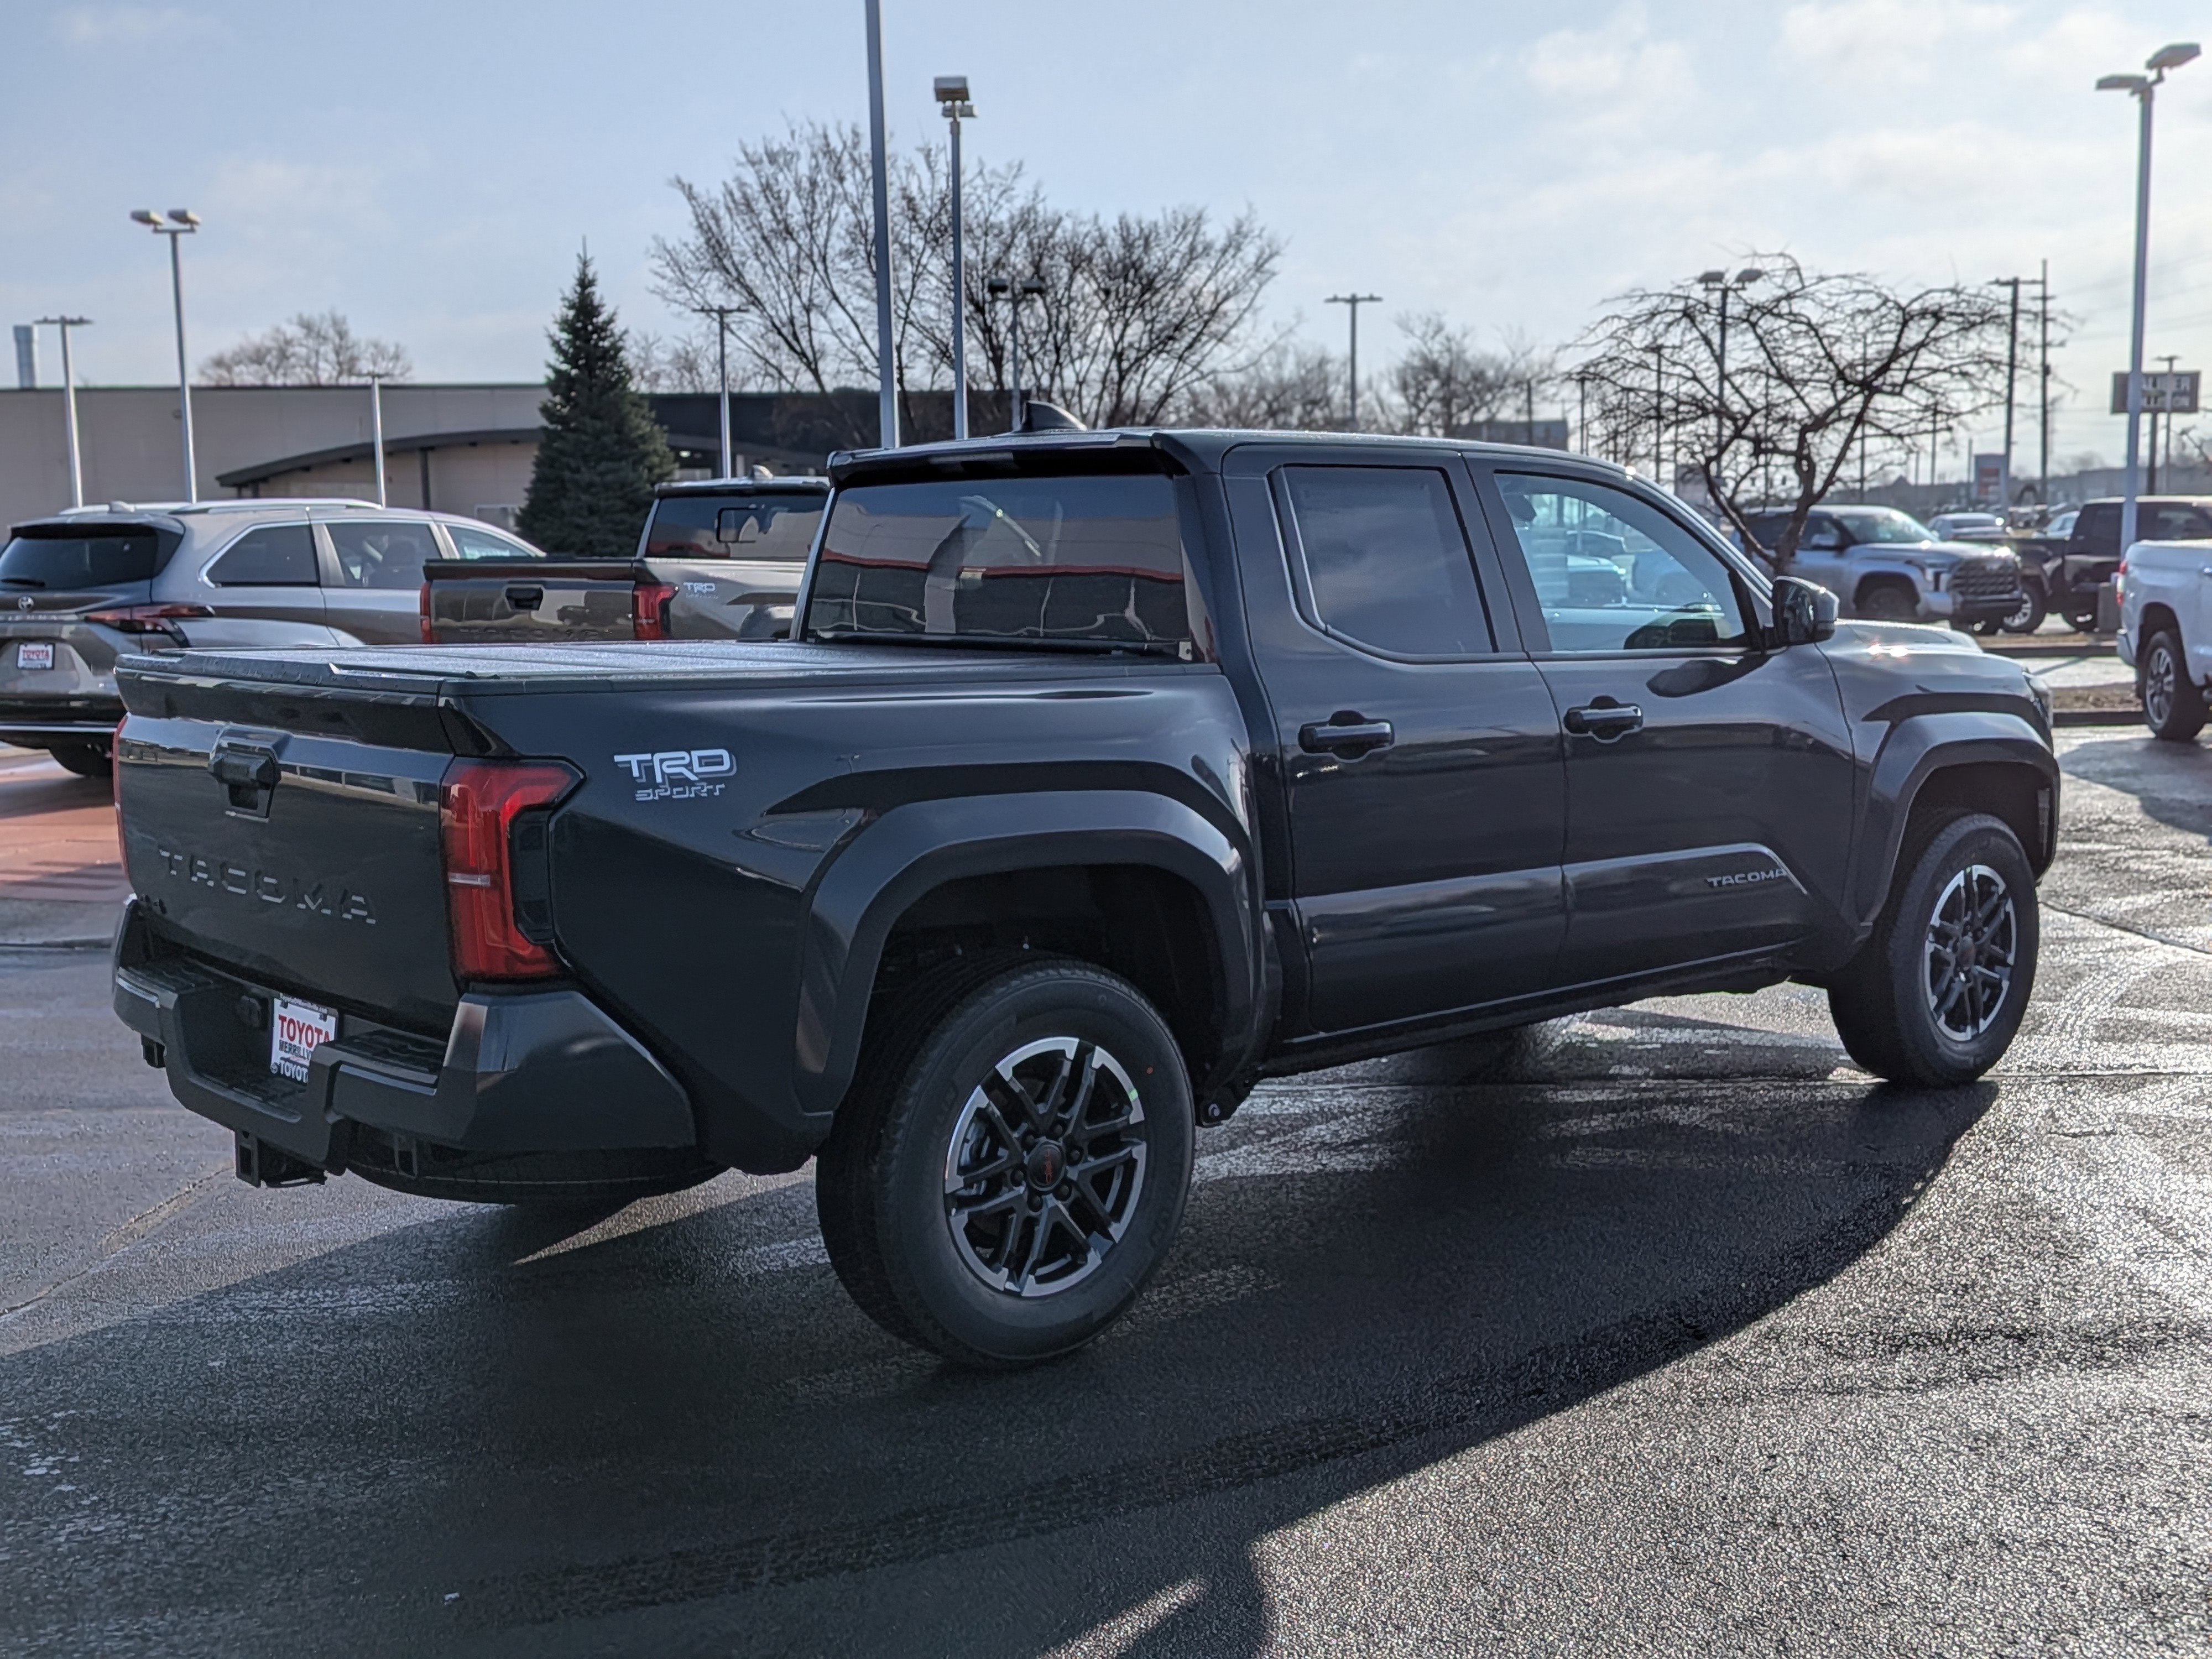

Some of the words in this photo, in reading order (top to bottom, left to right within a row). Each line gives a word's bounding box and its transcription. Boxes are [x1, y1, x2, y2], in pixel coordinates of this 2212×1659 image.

[683, 582, 716, 593] TRD
[614, 749, 733, 783] TRD
[635, 783, 725, 801] SPORT
[158, 846, 376, 925] TACOMA
[1707, 869, 1787, 887] TACOMA
[279, 1014, 330, 1048] TOYOTA
[279, 1040, 311, 1061] MERRILLV
[279, 1061, 309, 1083] TOYOT
